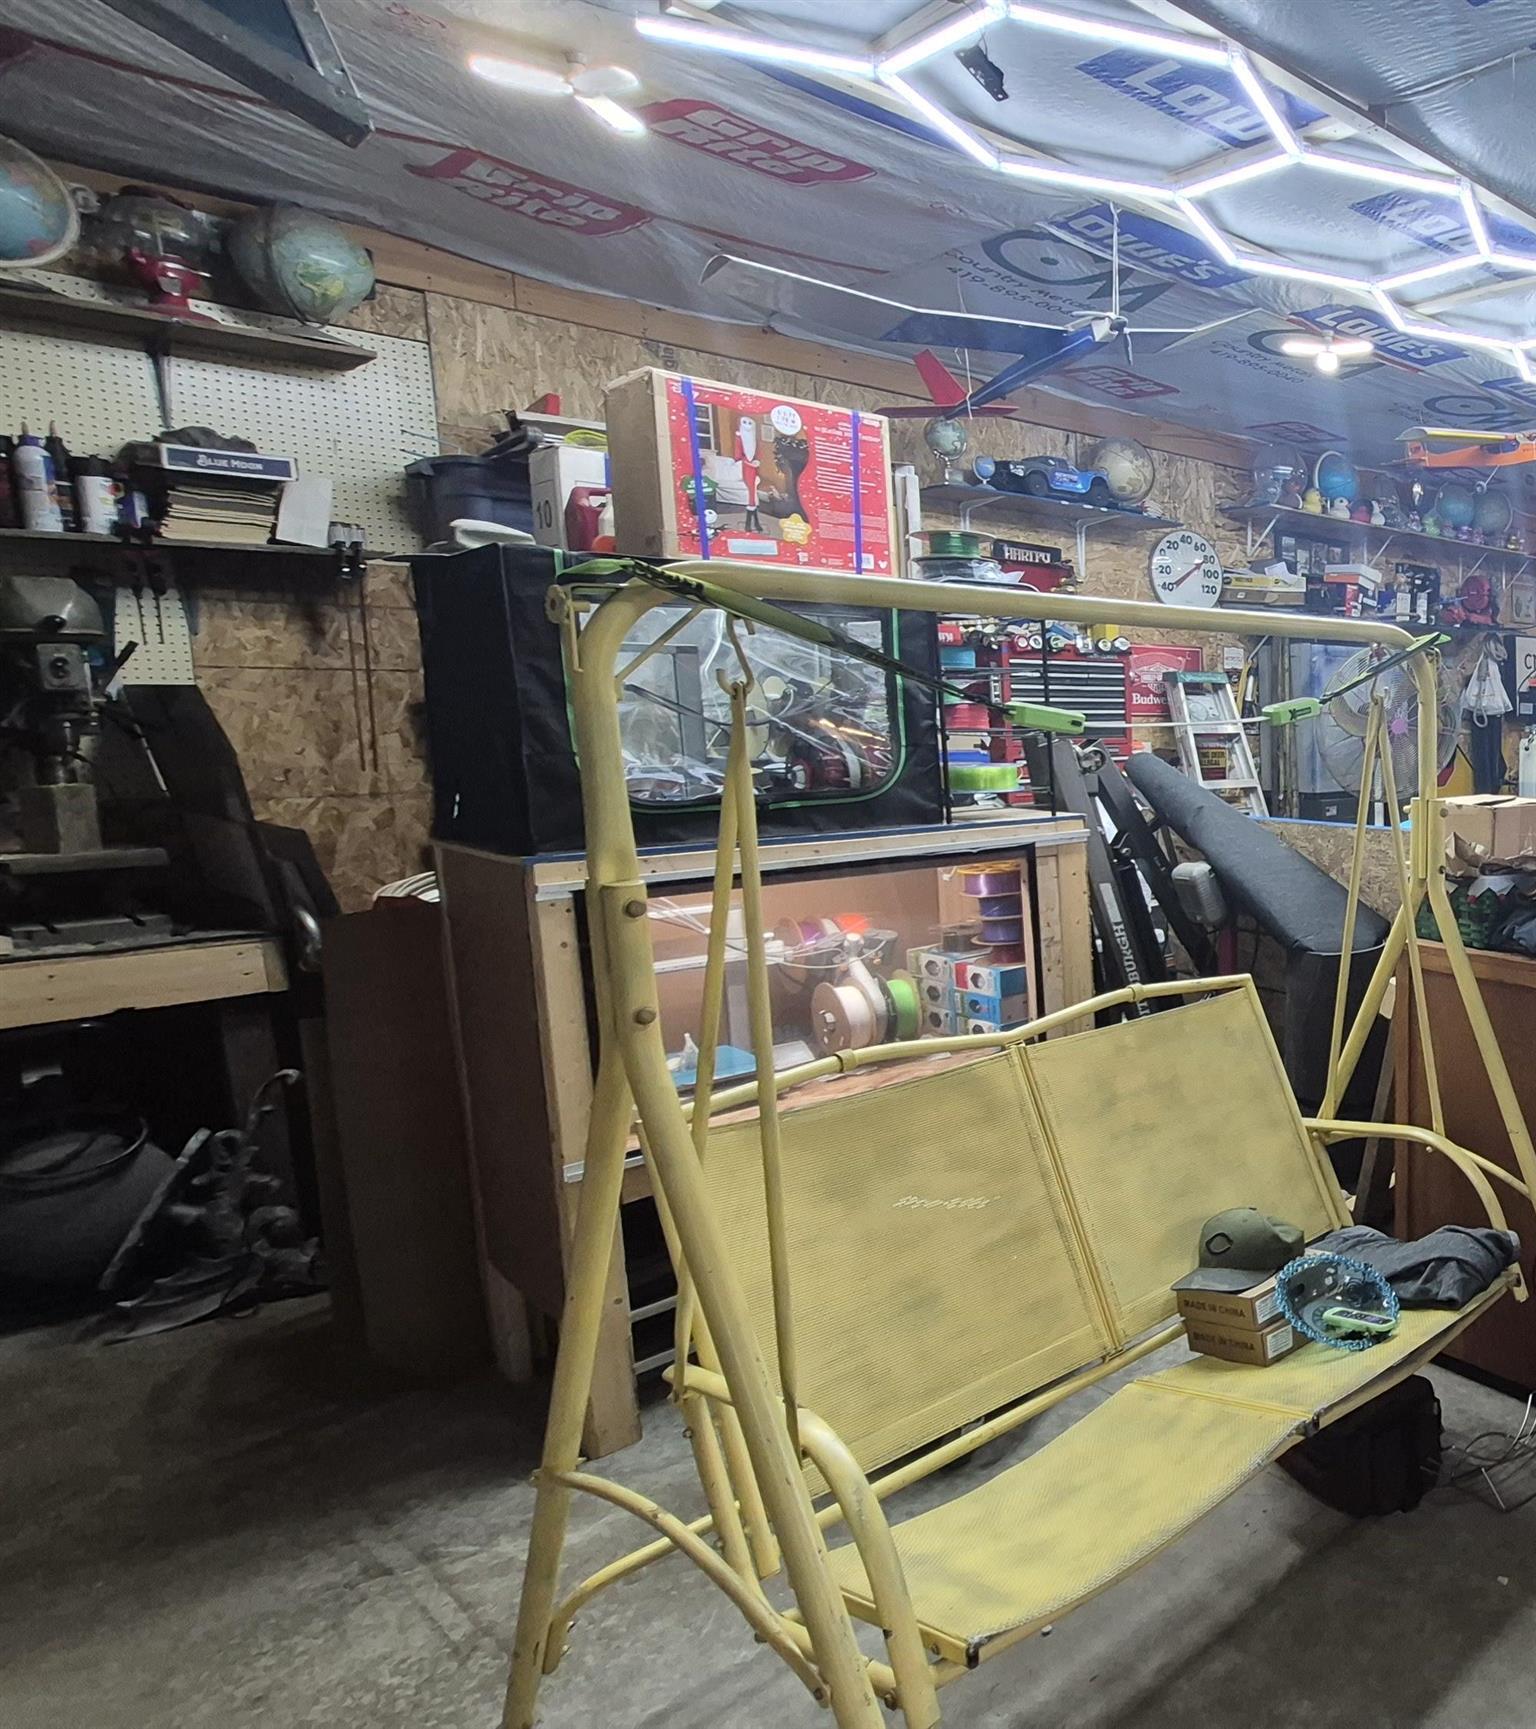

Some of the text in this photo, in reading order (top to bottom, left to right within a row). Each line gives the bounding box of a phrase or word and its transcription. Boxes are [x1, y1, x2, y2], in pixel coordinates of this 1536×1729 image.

[1166, 540, 1179, 550] 20
[1180, 534, 1193, 545] 40
[1194, 542, 1207, 552] 60
[1203, 554, 1216, 565] 80
[1203, 569, 1220, 580] 100
[1202, 584, 1218, 595] 120
[1219, 1304, 1246, 1318] CHINA
